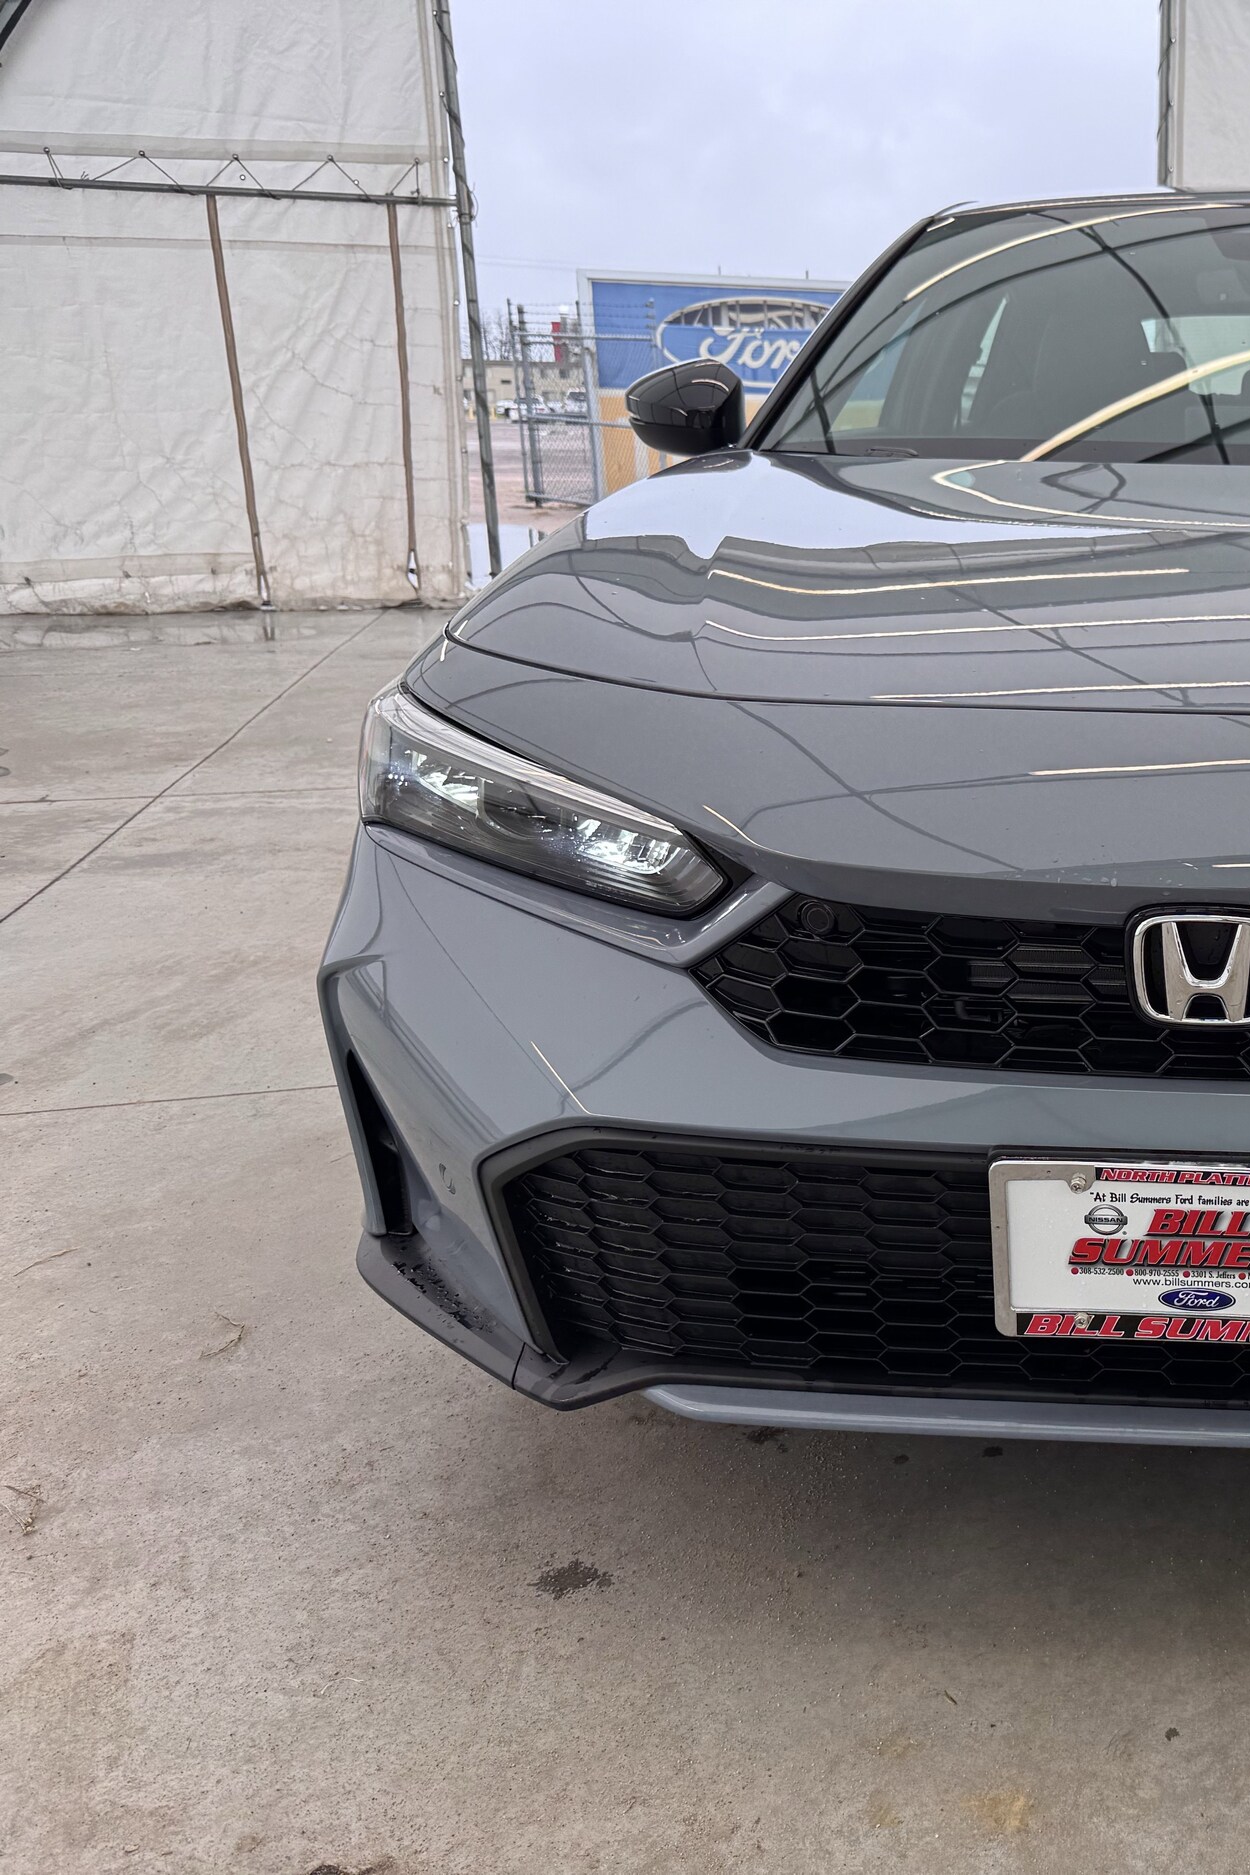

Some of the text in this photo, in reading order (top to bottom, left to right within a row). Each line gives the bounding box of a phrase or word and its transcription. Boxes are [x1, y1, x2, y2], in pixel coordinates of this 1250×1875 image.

[1100, 1168, 1177, 1182] NORTH
[1109, 1192, 1127, 1203] Bill
[1129, 1193, 1172, 1204] Summers
[1175, 1194, 1194, 1205] Ford
[1197, 1195, 1233, 1206] families
[1236, 1199, 1249, 1207] are
[1079, 1267, 1125, 1276] 308-532-2500
[1134, 1269, 1180, 1277] 800-970-2555
[1190, 1270, 1207, 1278] 3301
[1208, 1271, 1215, 1279] S.
[1216, 1272, 1236, 1280] Jeffers
[1174, 1290, 1220, 1308] Ford
